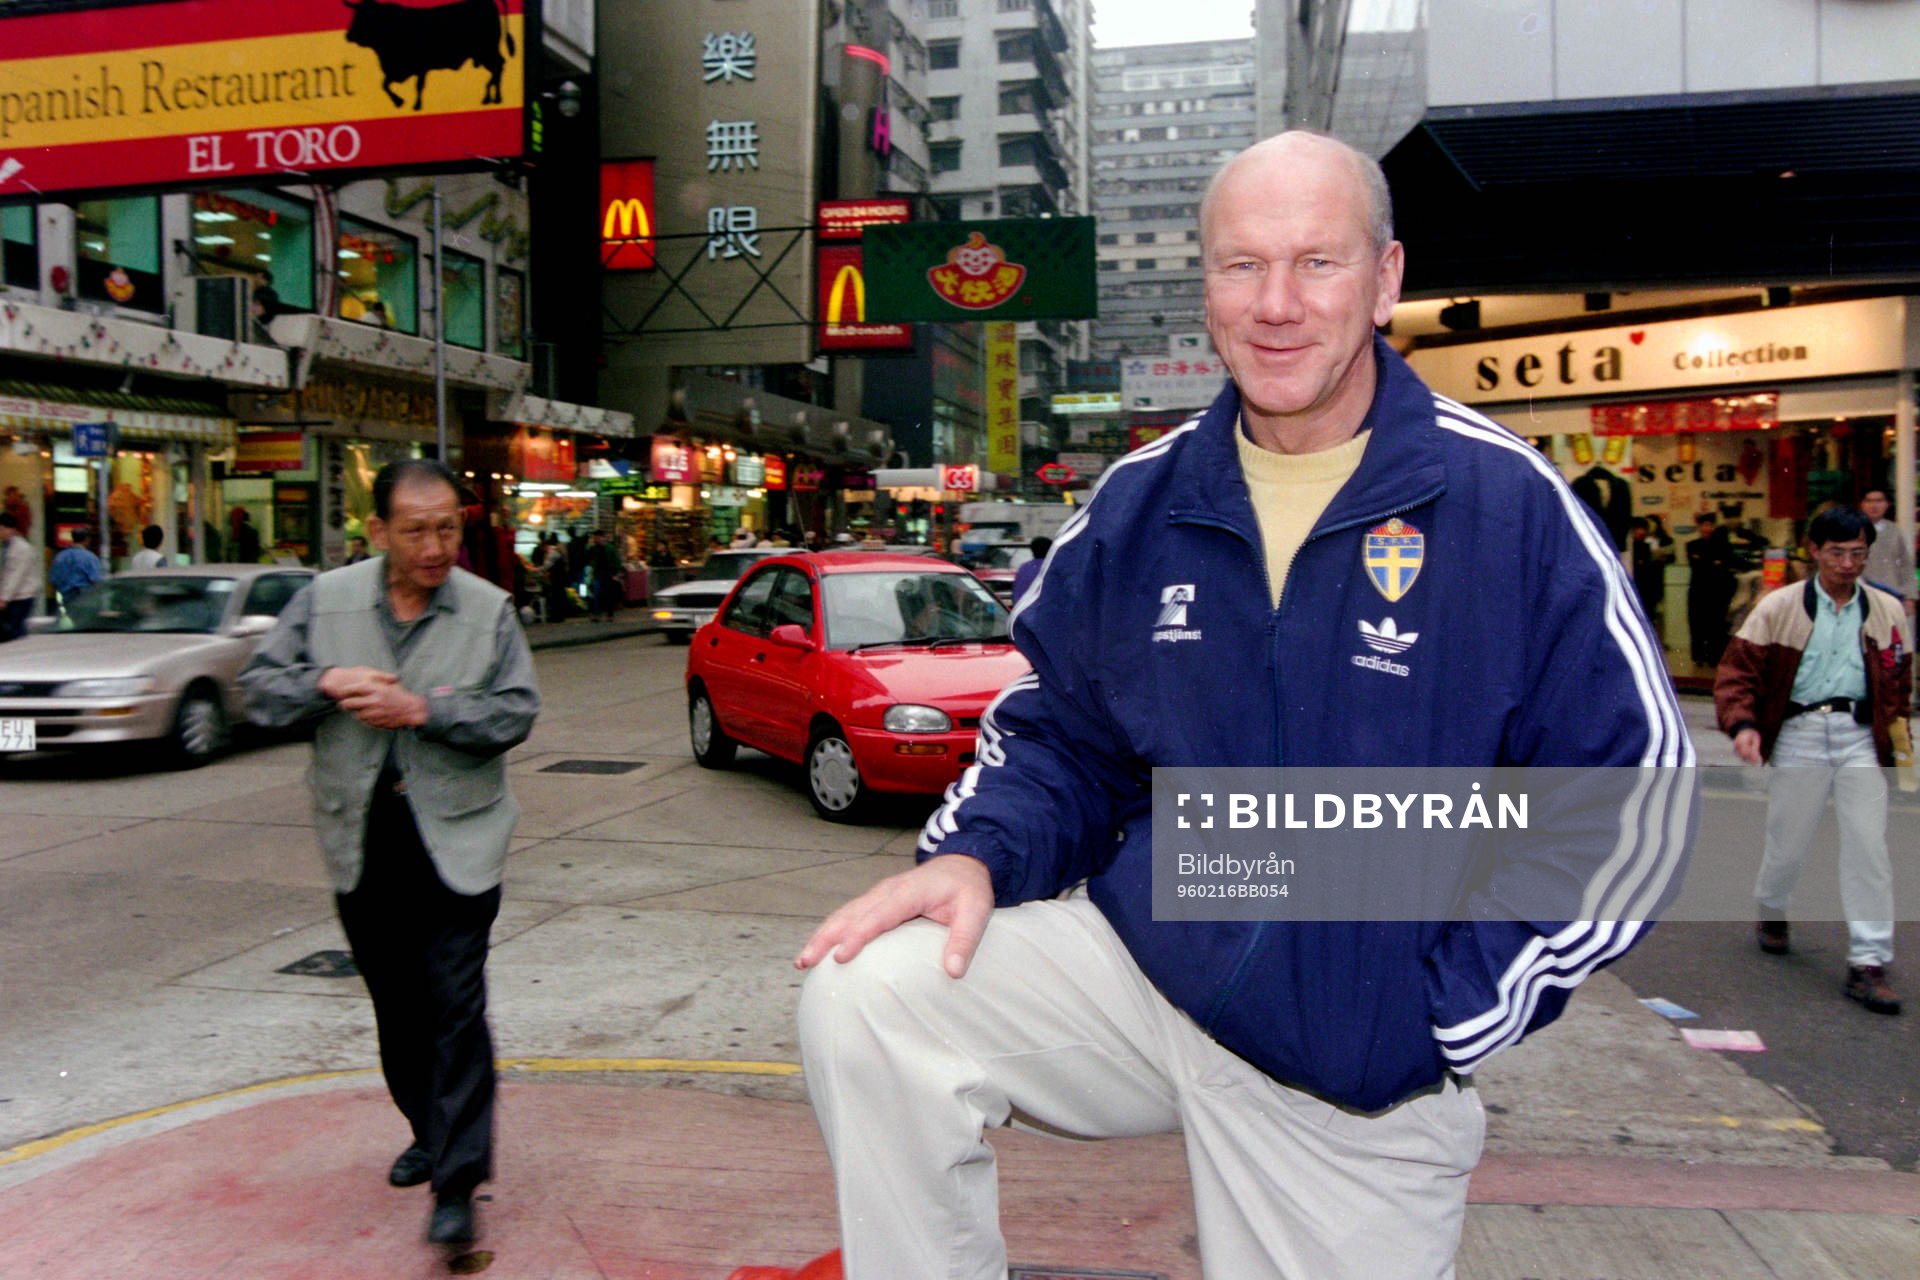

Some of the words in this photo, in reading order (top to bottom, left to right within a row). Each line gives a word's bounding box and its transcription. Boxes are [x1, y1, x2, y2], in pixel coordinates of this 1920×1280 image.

[140, 60, 356, 115] Restaurant
[187, 136, 235, 174] EL
[247, 124, 362, 169] TORO
[702, 31, 762, 261] 樂無限
[867, 204, 908, 217] HOURS
[826, 325, 903, 336] McDonald's
[1475, 340, 1623, 392] seta
[1673, 342, 1808, 371] Collection
[1637, 459, 1737, 483] seta
[1351, 655, 1410, 677] adidas
